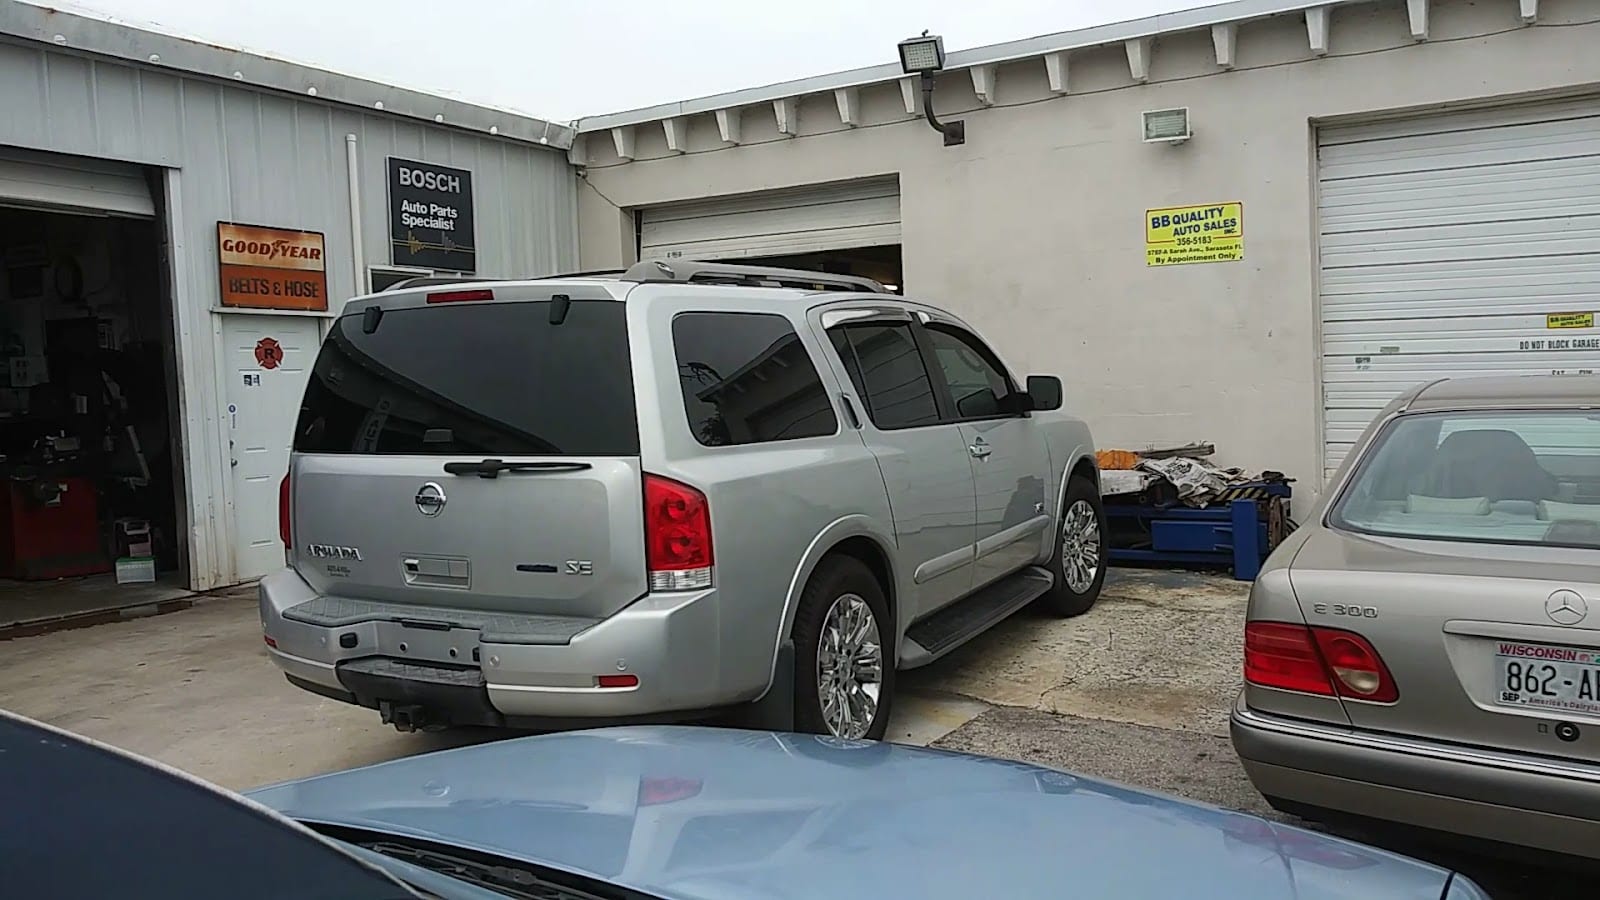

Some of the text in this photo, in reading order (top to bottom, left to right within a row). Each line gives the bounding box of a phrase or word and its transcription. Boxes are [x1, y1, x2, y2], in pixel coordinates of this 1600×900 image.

[399, 167, 461, 194] BOSCH
[401, 199, 458, 219] Auto Parts
[401, 212, 455, 231] Specialist
[1151, 207, 1224, 229] BB QUALITY
[1173, 218, 1236, 237] AUTO SALES
[222, 239, 321, 260] GOODYEAR
[1176, 236, 1212, 246] 356-5183
[1205, 244, 1233, 252] Sarasota
[1155, 252, 1236, 265] By Appointment Only
[229, 277, 320, 298] BELTS & HOSE
[1519, 339, 1600, 350] DO NOT BLOCK GARAGE
[264, 348, 275, 359] R
[307, 544, 363, 561] ARMADA
[565, 559, 592, 575] SE
[1313, 602, 1378, 618] E 300
[1499, 643, 1577, 661] WISCONSIN
[1502, 692, 1520, 702] SEP
